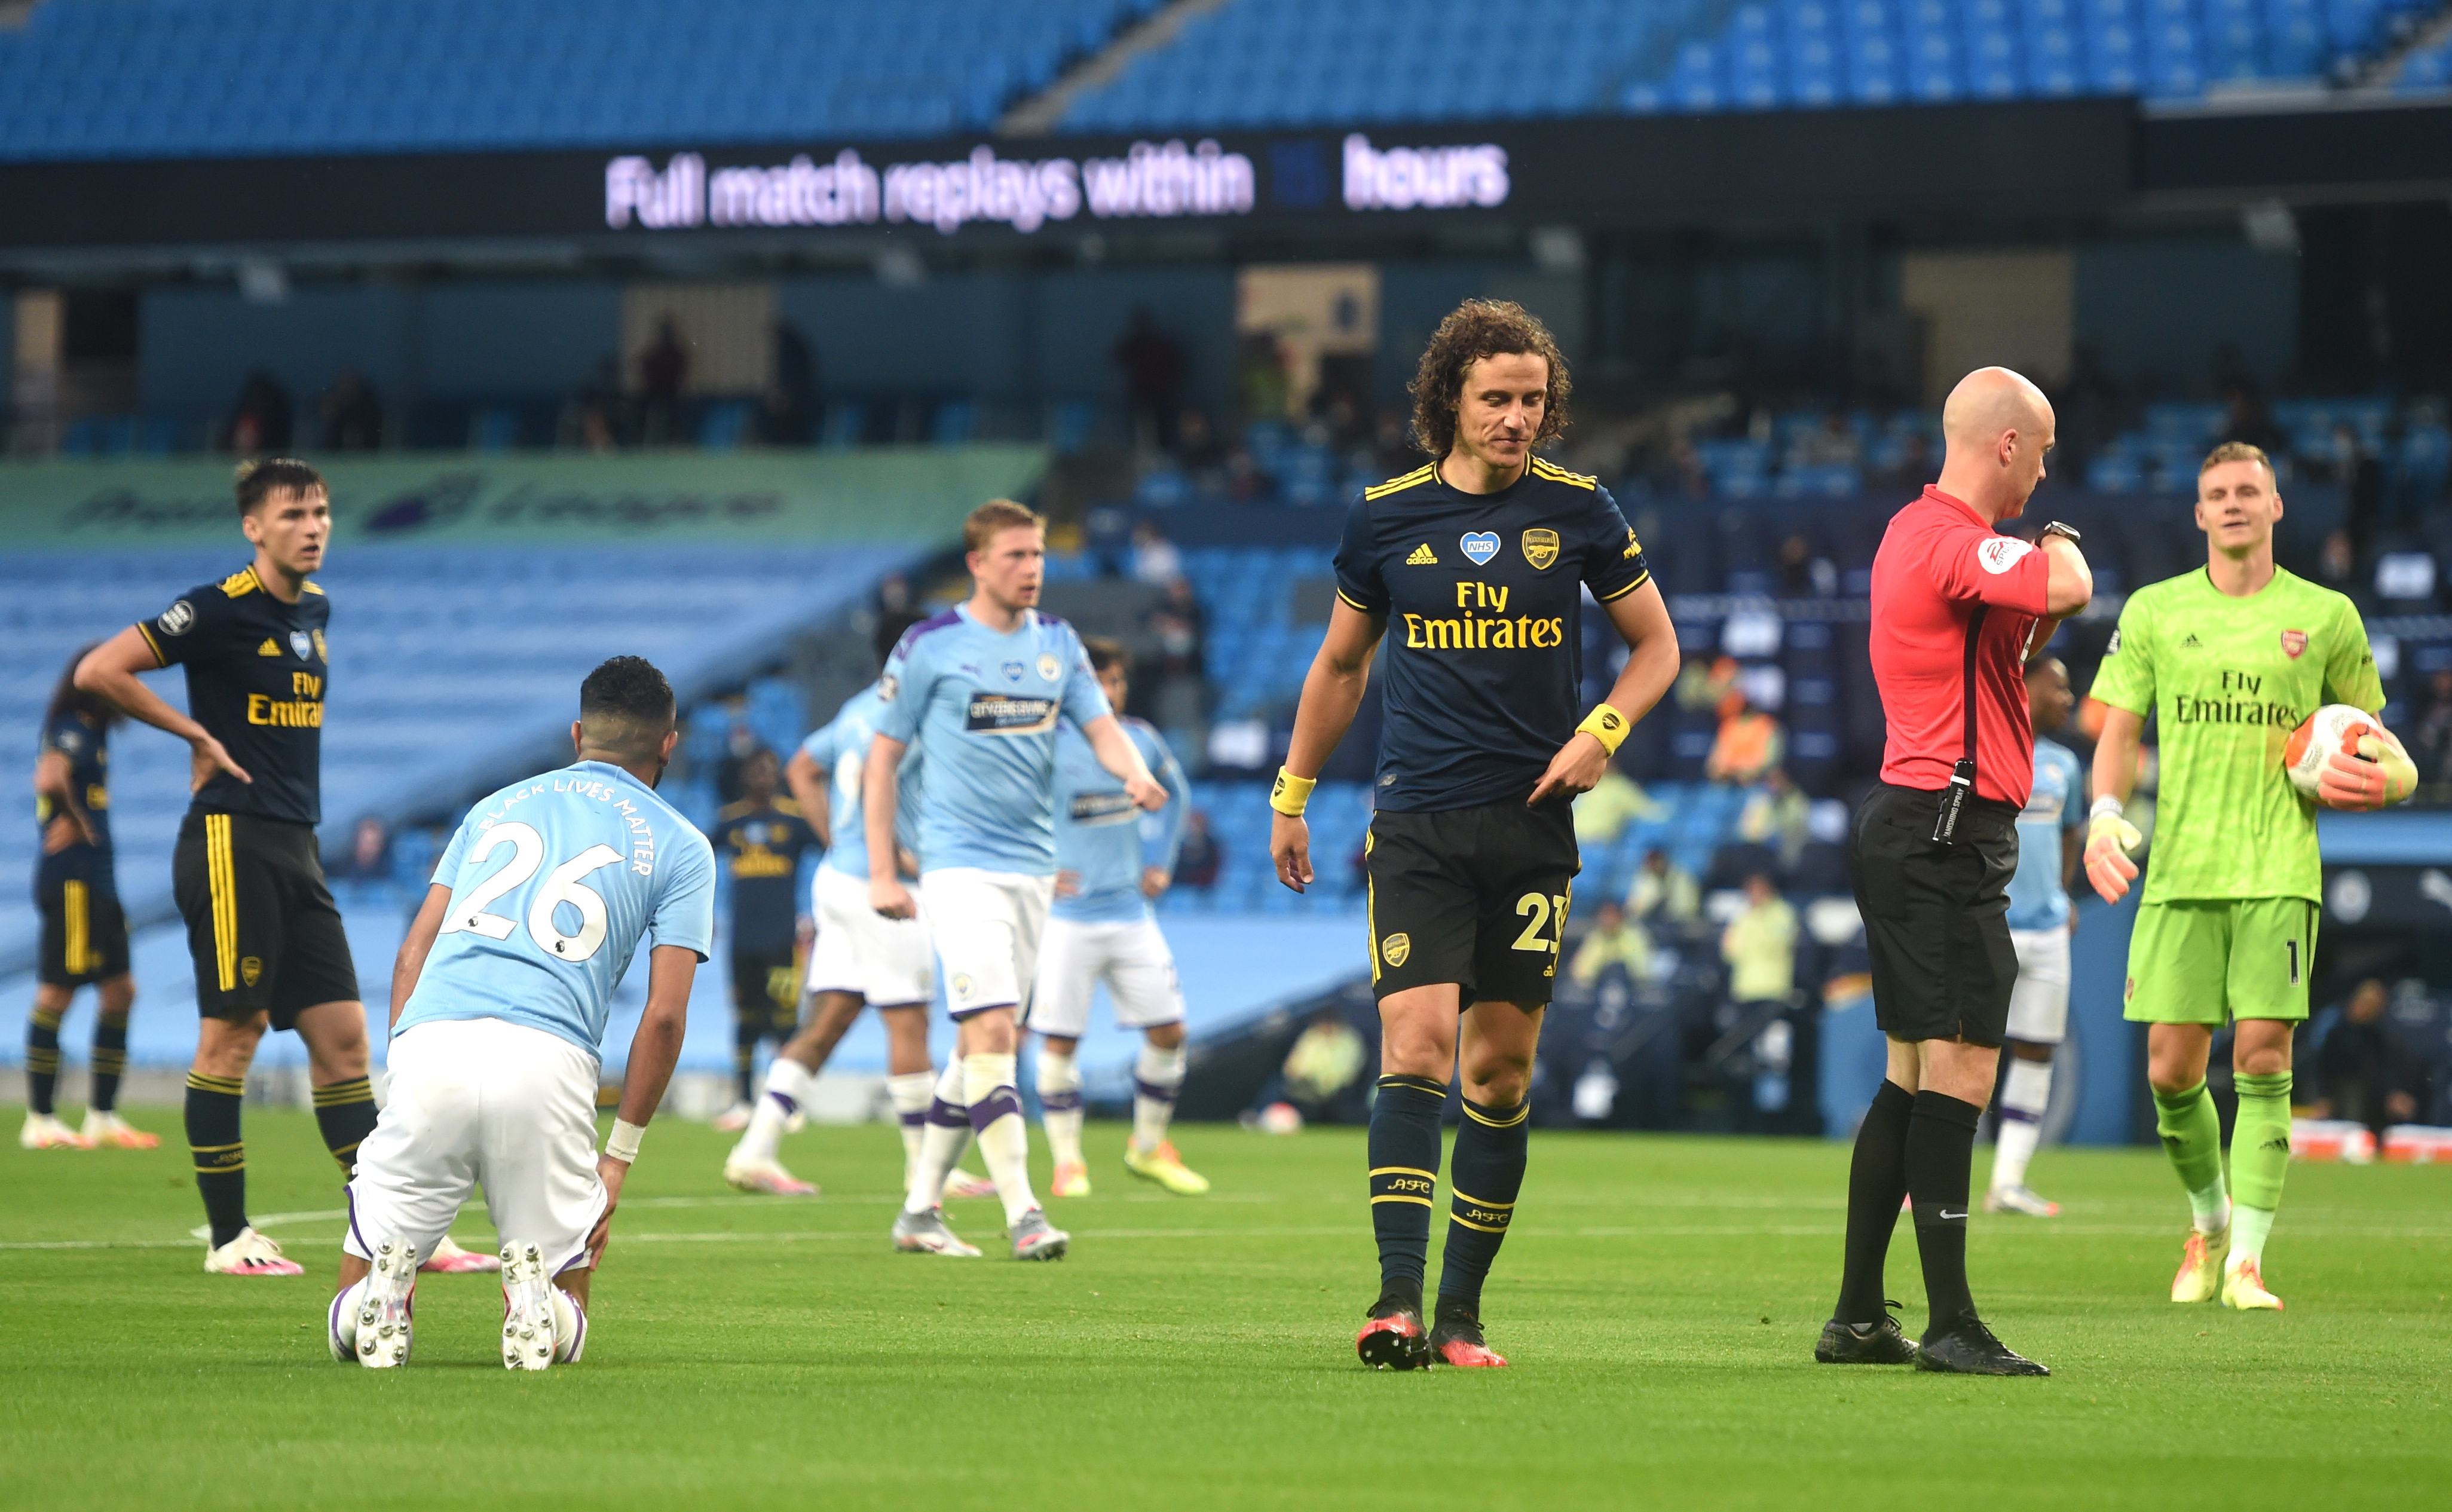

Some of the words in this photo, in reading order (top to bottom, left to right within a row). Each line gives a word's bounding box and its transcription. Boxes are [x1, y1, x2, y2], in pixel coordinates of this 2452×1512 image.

[605, 152, 706, 229] Full
[709, 148, 880, 227] match
[884, 145, 1079, 234] replays
[1082, 138, 1254, 219] within
[1343, 132, 1510, 210] hours
[1406, 556, 1438, 565] adidas
[1468, 542, 1492, 552] NHS
[1456, 581, 1508, 613] Fly
[1403, 610, 1562, 648] Emirates
[292, 671, 322, 699] Fly
[2223, 669, 2261, 696] Fly
[247, 692, 324, 728] Emira
[2177, 693, 2299, 732] Emirates
[1952, 788, 1964, 808] SPRAY
[478, 783, 545, 830] BLACK
[553, 779, 615, 801] LIVES
[613, 798, 654, 876] MATTER
[439, 821, 627, 963] 26
[2285, 938, 2300, 987] 1
[1387, 1179, 1430, 1193] AFC
[1466, 1208, 1508, 1223] AFC
